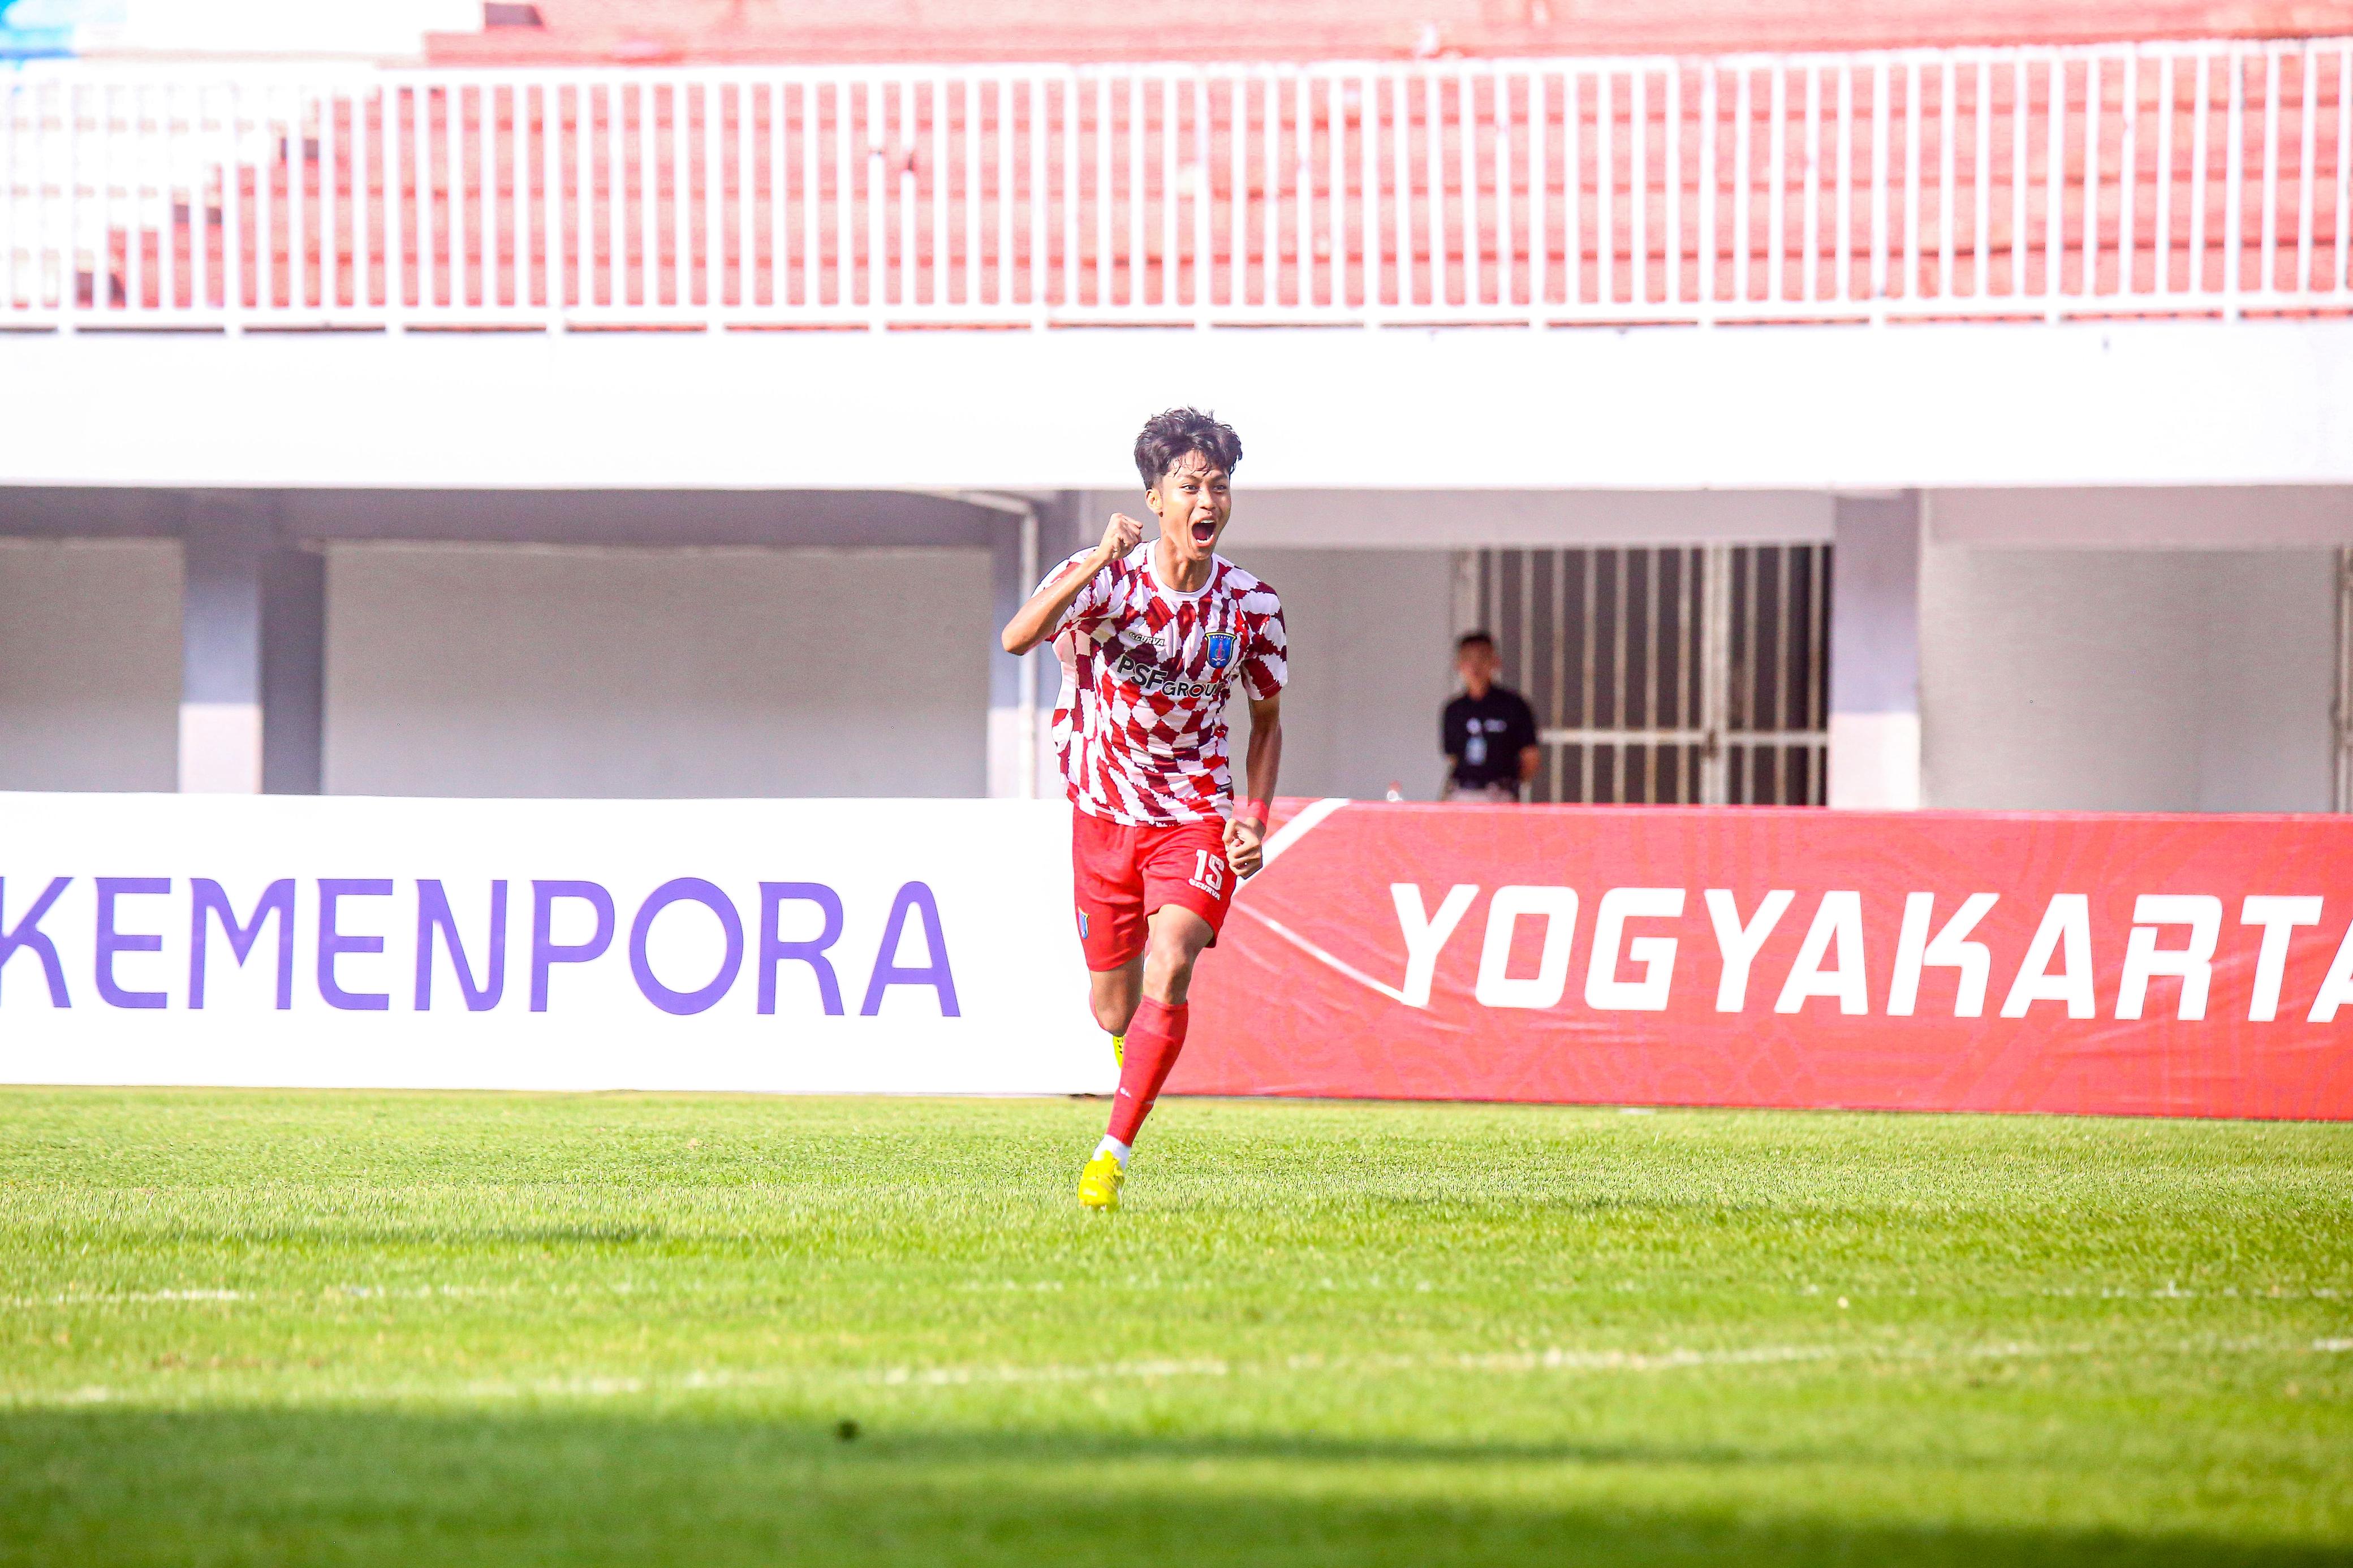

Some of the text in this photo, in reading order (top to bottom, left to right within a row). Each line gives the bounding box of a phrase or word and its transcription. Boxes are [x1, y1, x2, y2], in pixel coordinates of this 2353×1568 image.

[1135, 634, 1165, 646] CURVA
[1117, 654, 1168, 689] PSF
[1194, 849, 1225, 890] 15
[0, 877, 960, 1017] KEMENPORA
